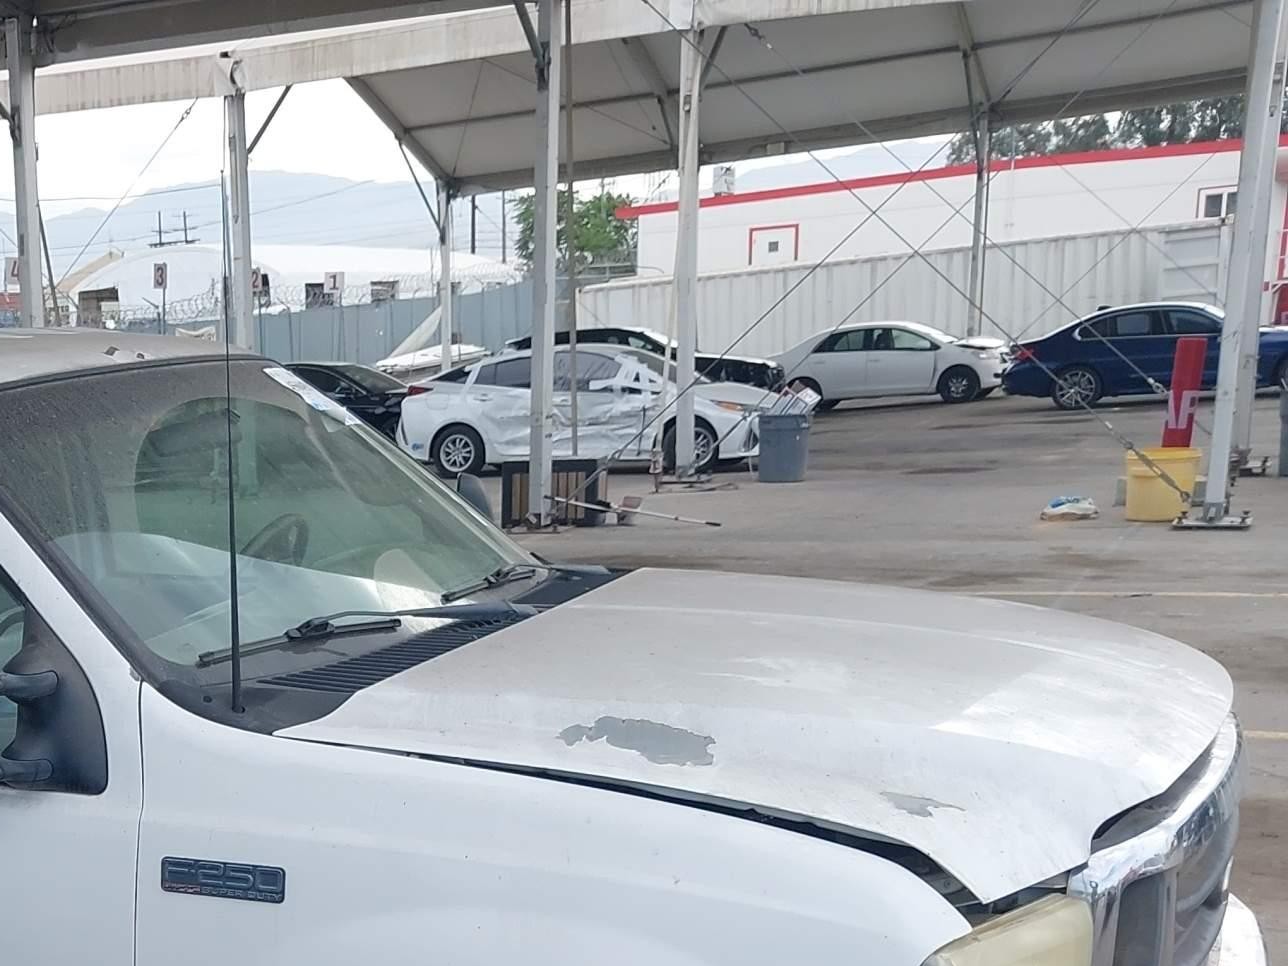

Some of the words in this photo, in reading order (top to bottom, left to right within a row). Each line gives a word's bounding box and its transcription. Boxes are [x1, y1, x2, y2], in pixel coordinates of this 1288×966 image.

[156, 267, 164, 286] 3
[252, 271, 259, 288] 2
[330, 274, 339, 290] 1
[200, 886, 244, 898] SUPER
[247, 890, 283, 901] DUTY
